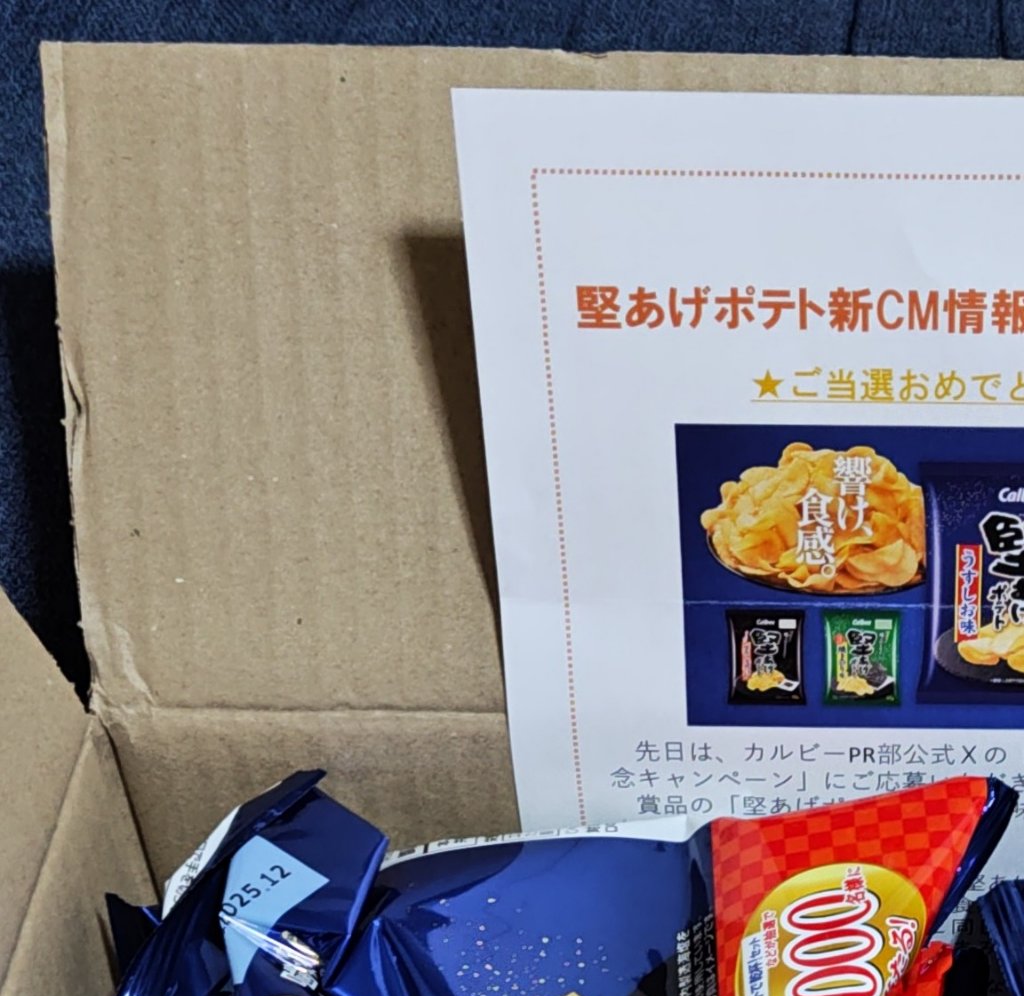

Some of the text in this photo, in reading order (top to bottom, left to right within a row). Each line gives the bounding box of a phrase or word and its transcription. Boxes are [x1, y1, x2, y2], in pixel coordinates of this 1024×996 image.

[959, 548, 978, 638] うすしお味
